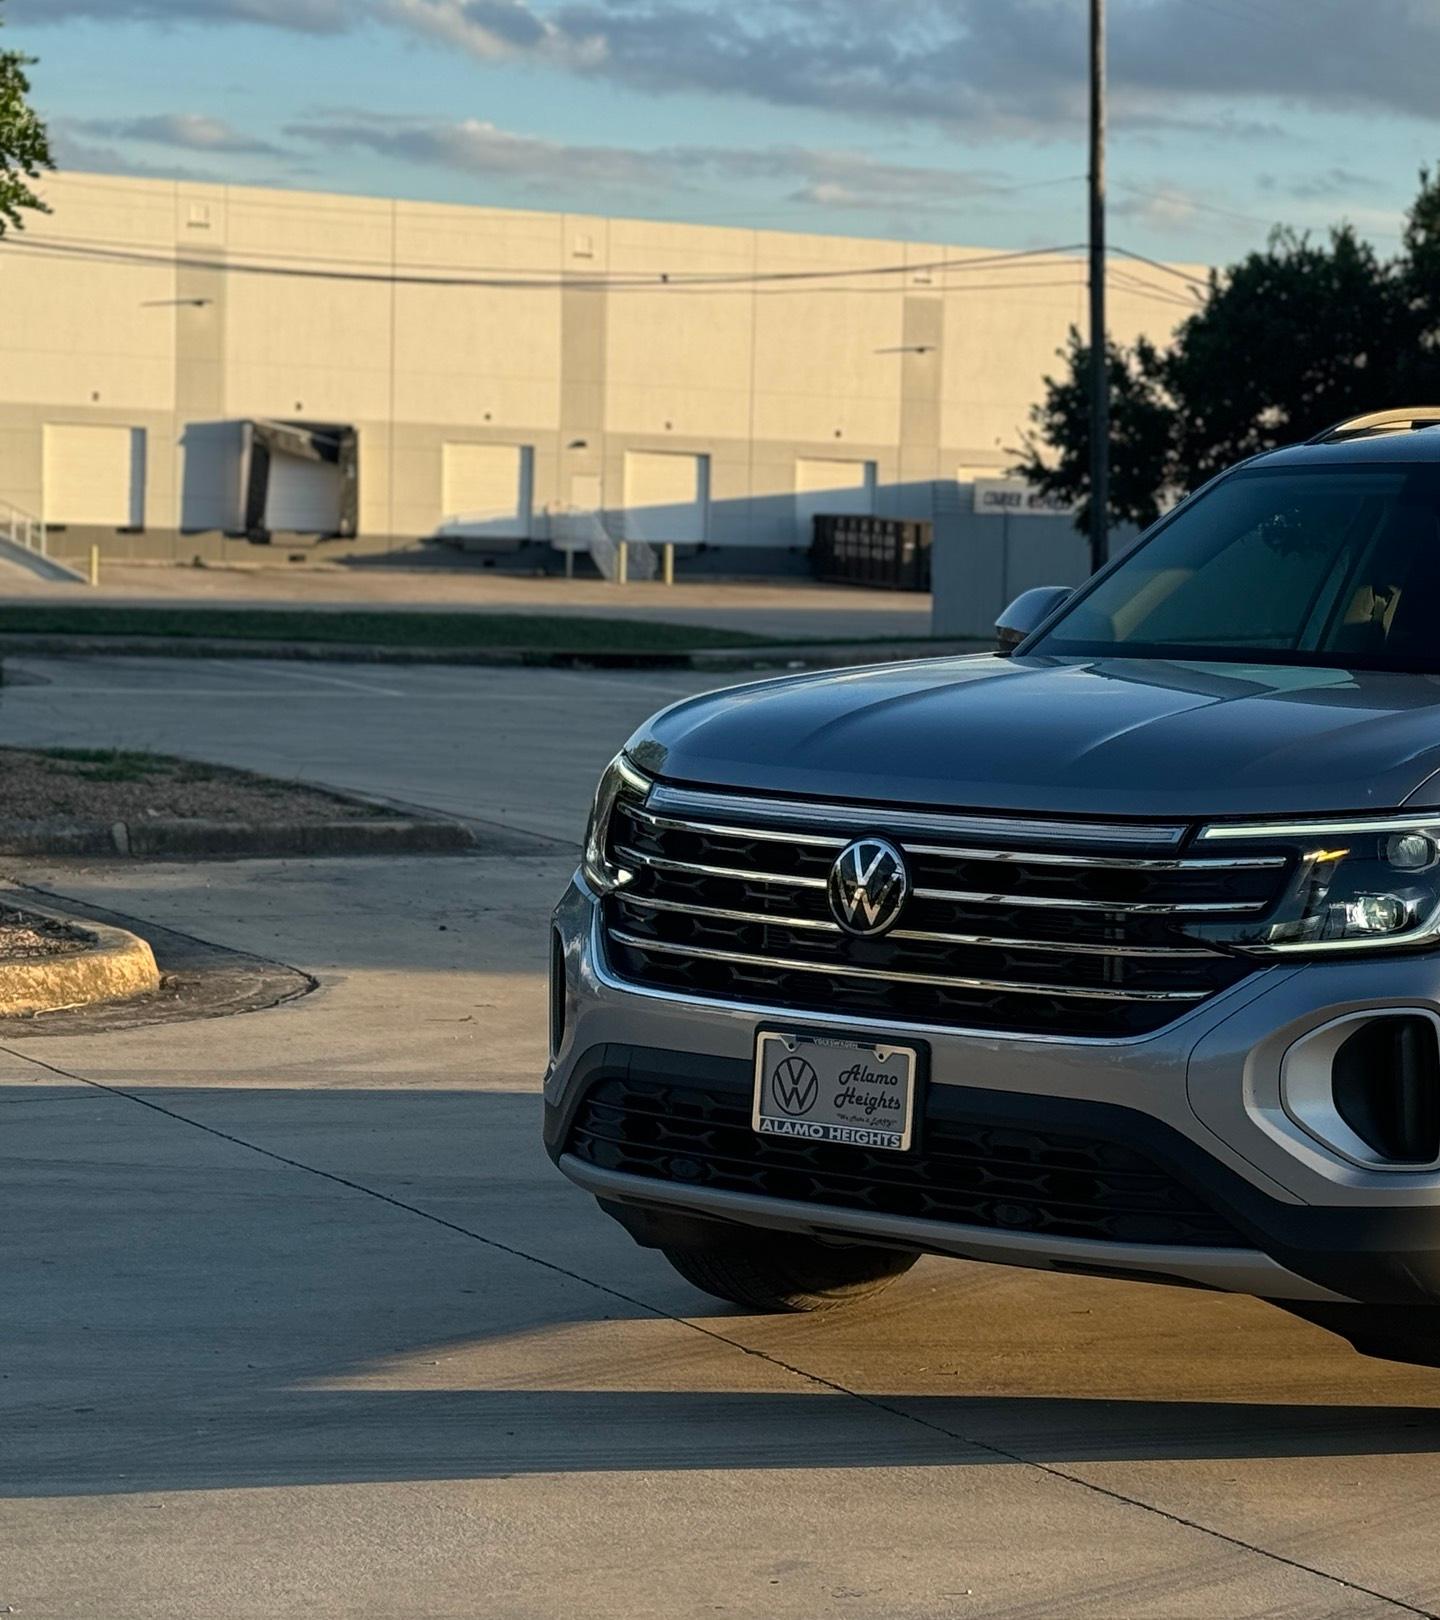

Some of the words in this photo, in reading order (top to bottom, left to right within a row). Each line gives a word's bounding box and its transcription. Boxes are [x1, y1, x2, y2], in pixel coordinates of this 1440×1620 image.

[829, 838, 909, 935] VW
[772, 1056, 818, 1116] VW
[838, 1064, 898, 1086] Alamo
[833, 1087, 901, 1115] Heights
[761, 1119, 824, 1138] ALAMO
[828, 1127, 902, 1148] HEIGHTS
